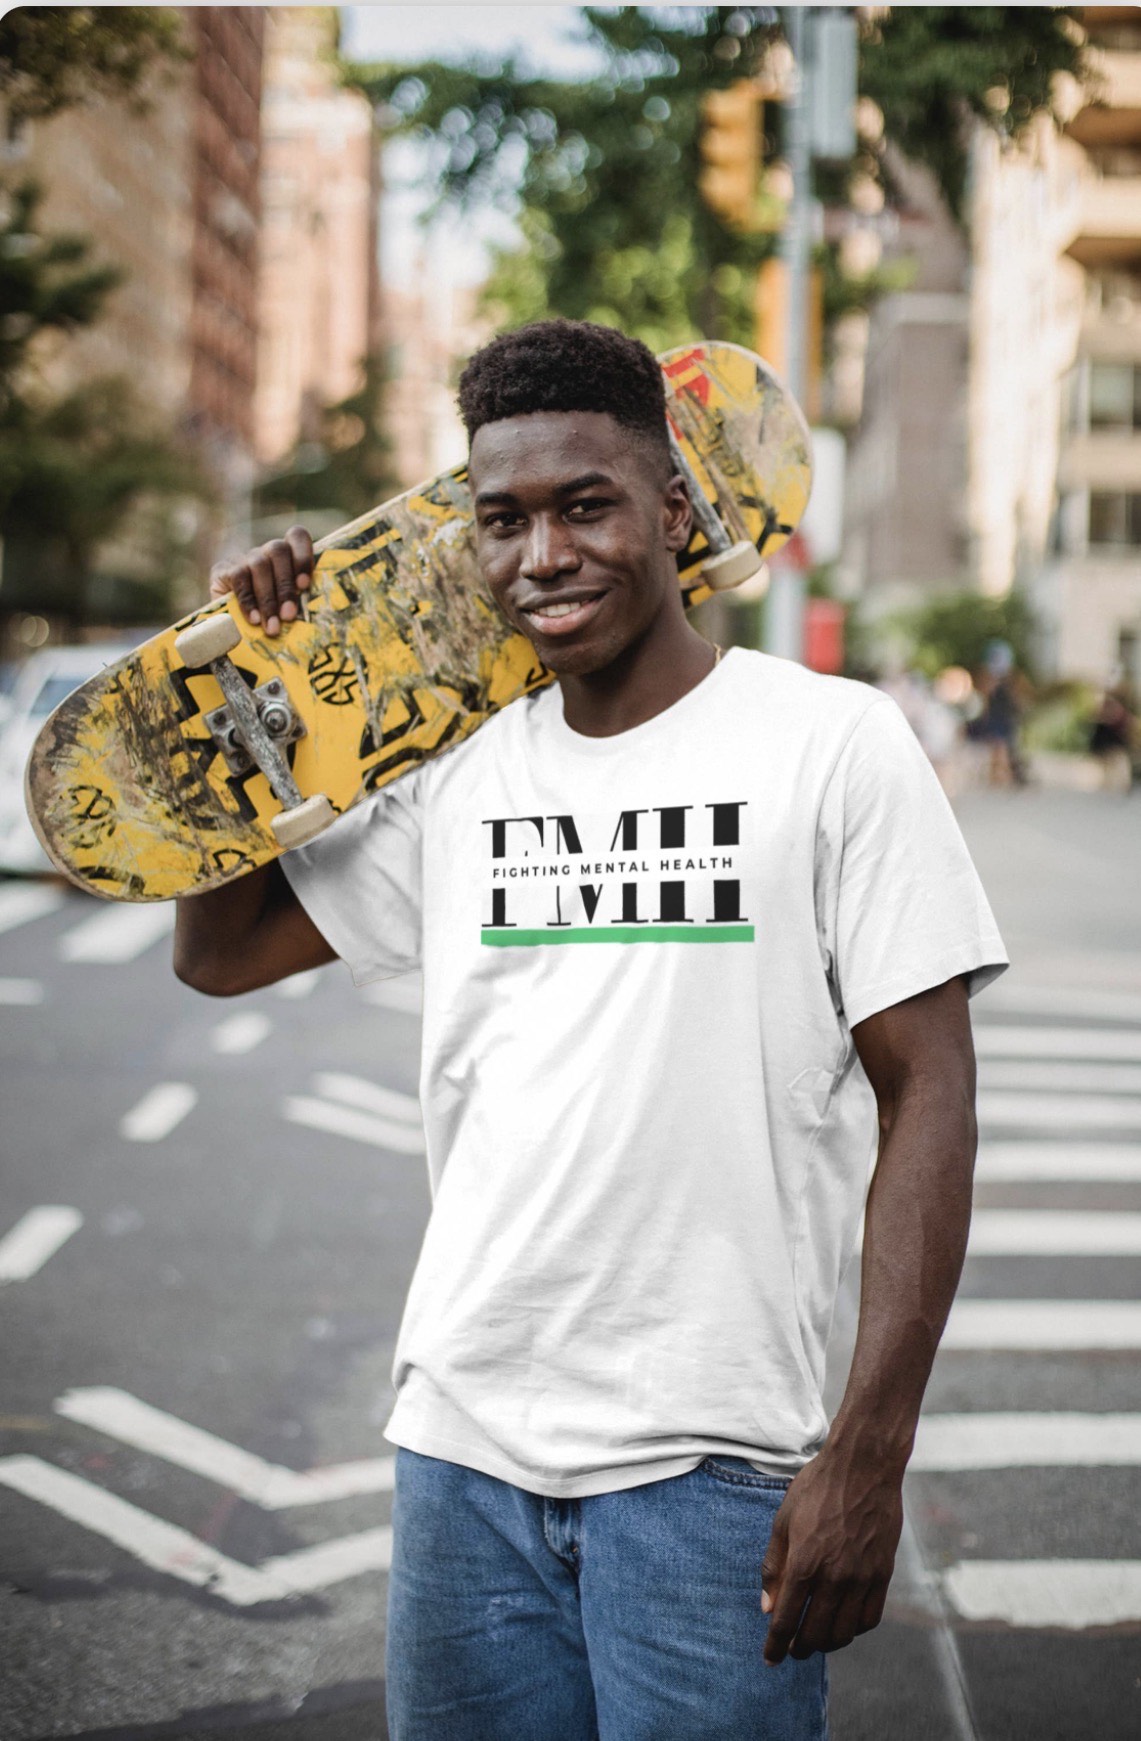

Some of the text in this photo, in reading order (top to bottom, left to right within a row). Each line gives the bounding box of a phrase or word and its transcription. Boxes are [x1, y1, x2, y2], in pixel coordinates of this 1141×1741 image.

[482, 801, 749, 927] FMH
[493, 857, 733, 878] FIGHTING MENTAL HEALTH
